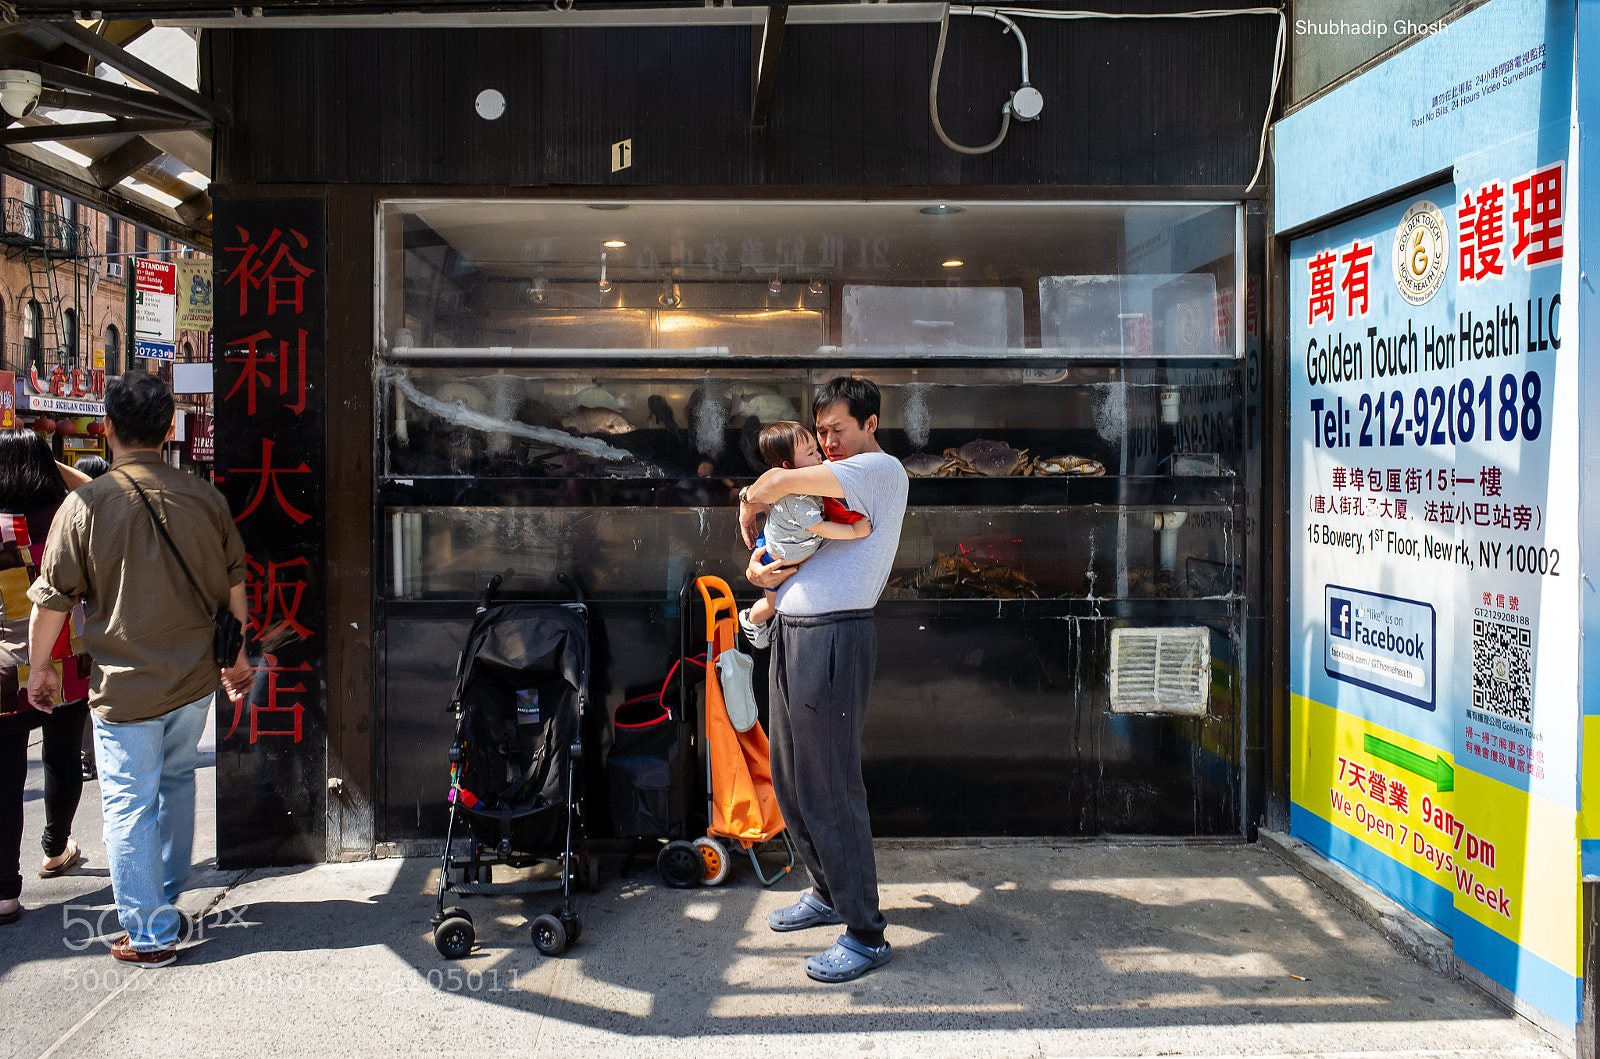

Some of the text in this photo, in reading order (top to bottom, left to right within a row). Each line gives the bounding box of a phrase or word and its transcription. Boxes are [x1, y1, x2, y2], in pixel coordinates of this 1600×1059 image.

[1411, 115, 1425, 129] Post
[1425, 110, 1434, 121] No
[1451, 99, 1459, 111] 24
[1460, 90, 1480, 107] Hours
[1481, 81, 1501, 96] Video
[1502, 60, 1547, 87] Surveillance
[1399, 215, 1420, 251] GOLDEN
[1422, 215, 1441, 242] TOUCH
[1458, 165, 1563, 282] 護理
[141, 261, 169, 273] STANDING
[1307, 241, 1373, 325] 萬有
[1400, 262, 1412, 289] HOME
[1413, 271, 1435, 291] HEALTH
[1306, 332, 1363, 386] Golden
[1367, 318, 1418, 379] Touch
[1459, 309, 1520, 362] Health
[1527, 293, 1562, 353] LLC
[43, 400, 53, 409] OLD
[1310, 396, 1351, 449] Tel:
[1307, 523, 1320, 544] 15
[1322, 525, 1365, 553] Bowery,
[1368, 528, 1384, 551] 1ST
[1387, 531, 1420, 561] Floor,
[1424, 534, 1453, 560] New
[1479, 541, 1502, 568] NY
[1506, 542, 1560, 577] 10002
[1474, 607, 1530, 625] GT2129208188
[1483, 591, 1519, 611] 微信號
[1355, 621, 1425, 660] Facebook
[1385, 615, 1393, 624] us
[1395, 617, 1403, 627] on
[1502, 721, 1524, 736] Golden
[1525, 728, 1544, 742] Touch
[1337, 756, 1410, 815] 7天營業
[1330, 788, 1512, 919] We Open 7 Days Week
